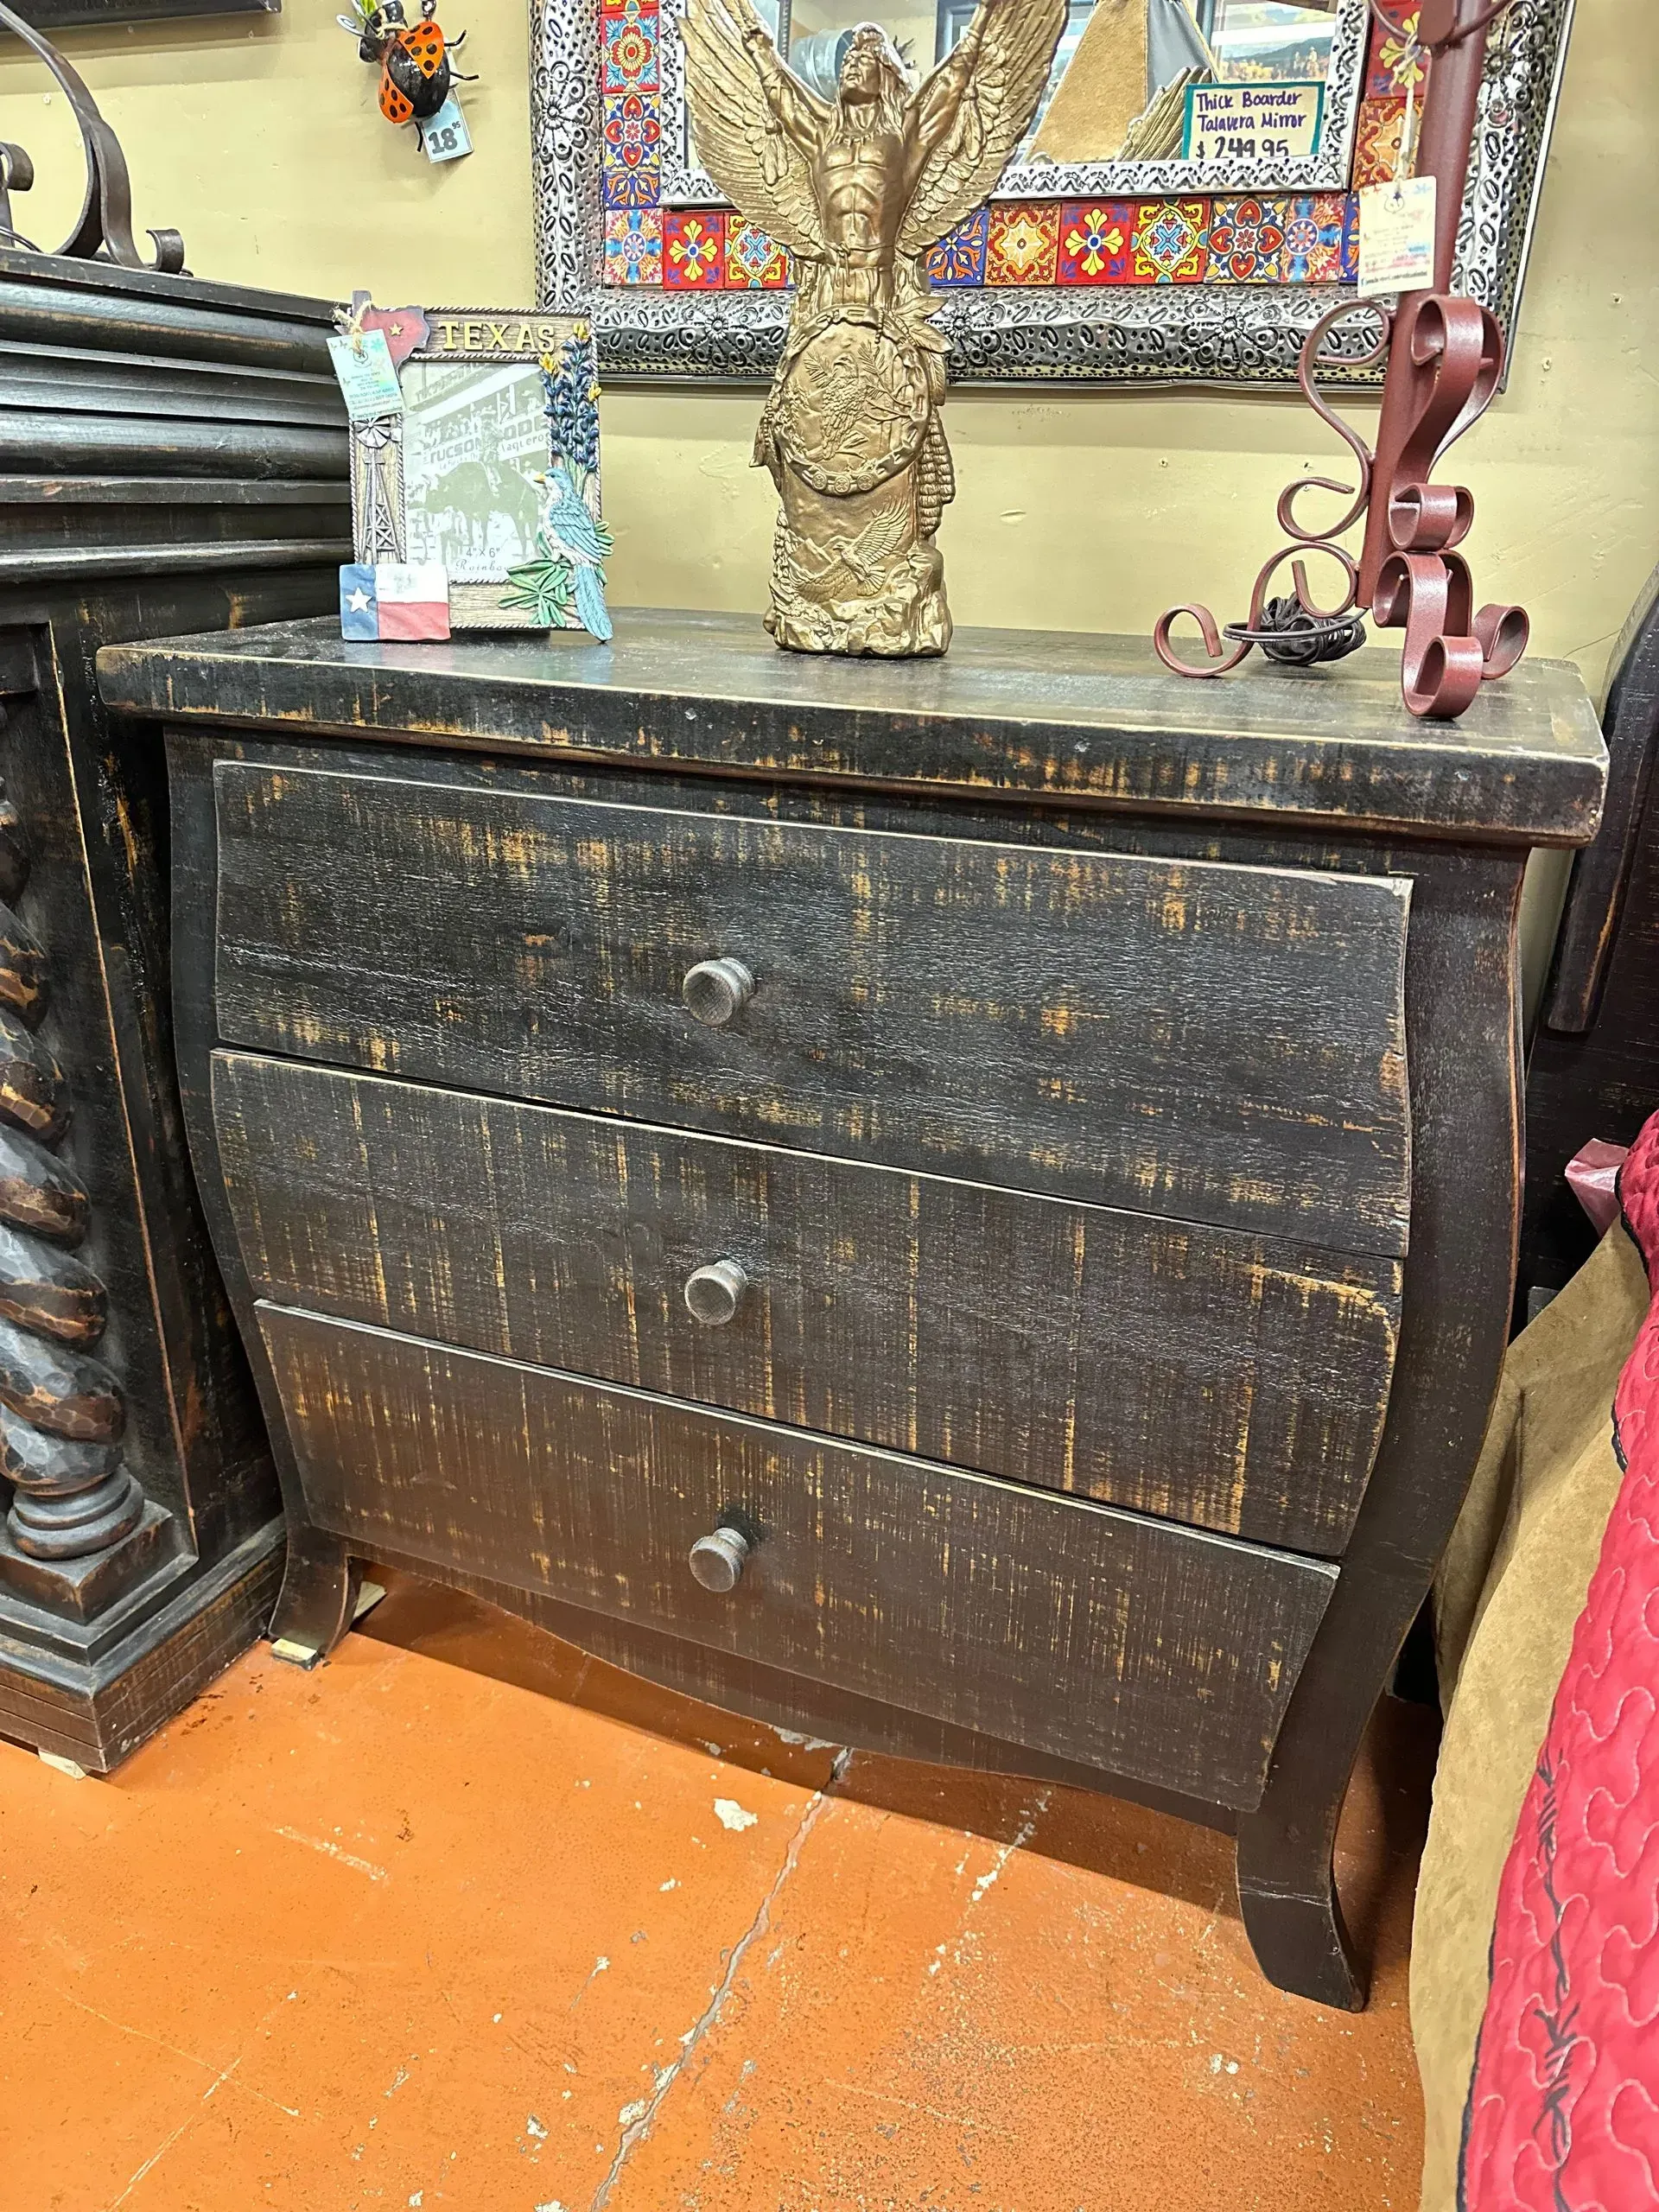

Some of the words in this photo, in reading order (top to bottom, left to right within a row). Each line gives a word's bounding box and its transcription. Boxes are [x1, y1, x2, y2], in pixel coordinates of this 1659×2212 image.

[1196, 92, 1234, 112] Thick
[1242, 91, 1302, 108] Boarder
[1196, 114, 1255, 132] Talavera
[1261, 111, 1307, 129] Mirror
[428, 128, 458, 154] 18
[437, 321, 554, 353] TEXAS
[429, 436, 482, 464] TUCSON
